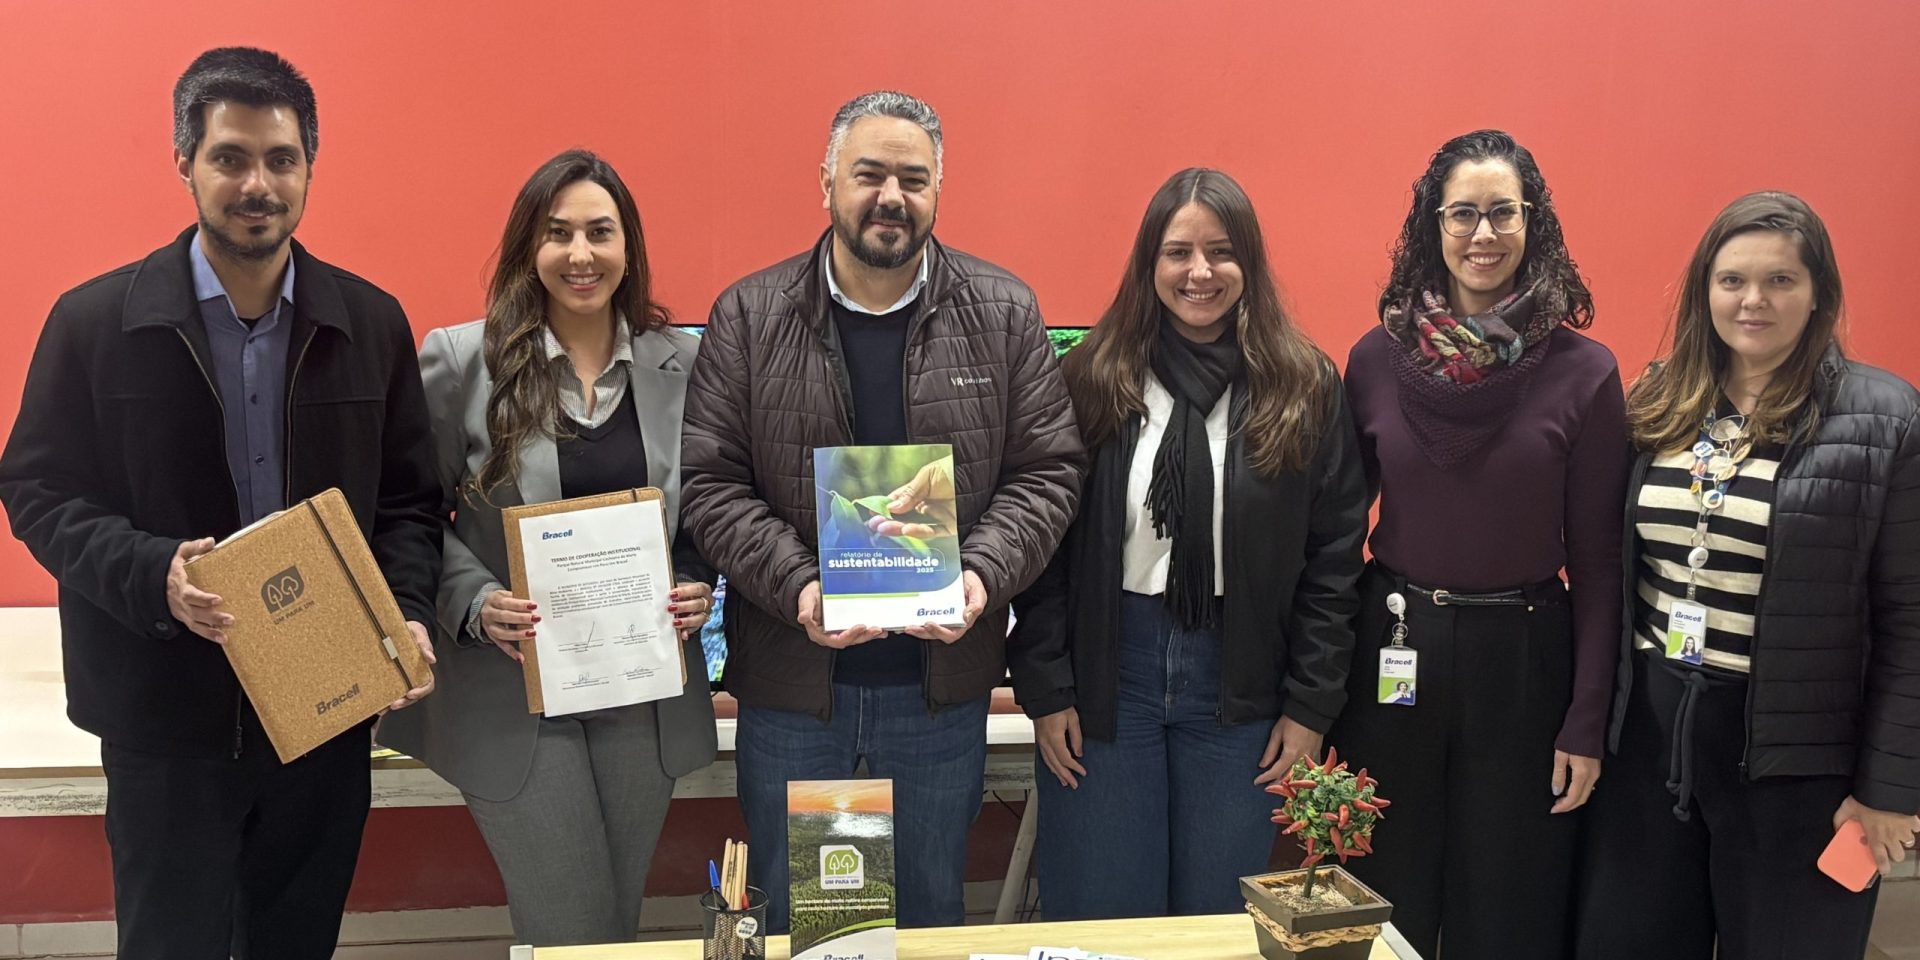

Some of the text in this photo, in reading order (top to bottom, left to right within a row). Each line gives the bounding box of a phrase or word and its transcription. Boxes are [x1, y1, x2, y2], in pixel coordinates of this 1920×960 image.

[951, 377, 964, 386] VR
[542, 529, 573, 540] Bracell
[576, 551, 607, 560] COOPERAÇÃO
[607, 546, 641, 555] INSTITUCIONAL
[828, 557, 939, 568] sustentabilidade
[273, 600, 315, 625] UM PARA UM
[917, 607, 955, 616] Bracell
[1675, 611, 1702, 622] Bracell
[1385, 657, 1412, 666] Bracell
[315, 683, 360, 715] Bracell
